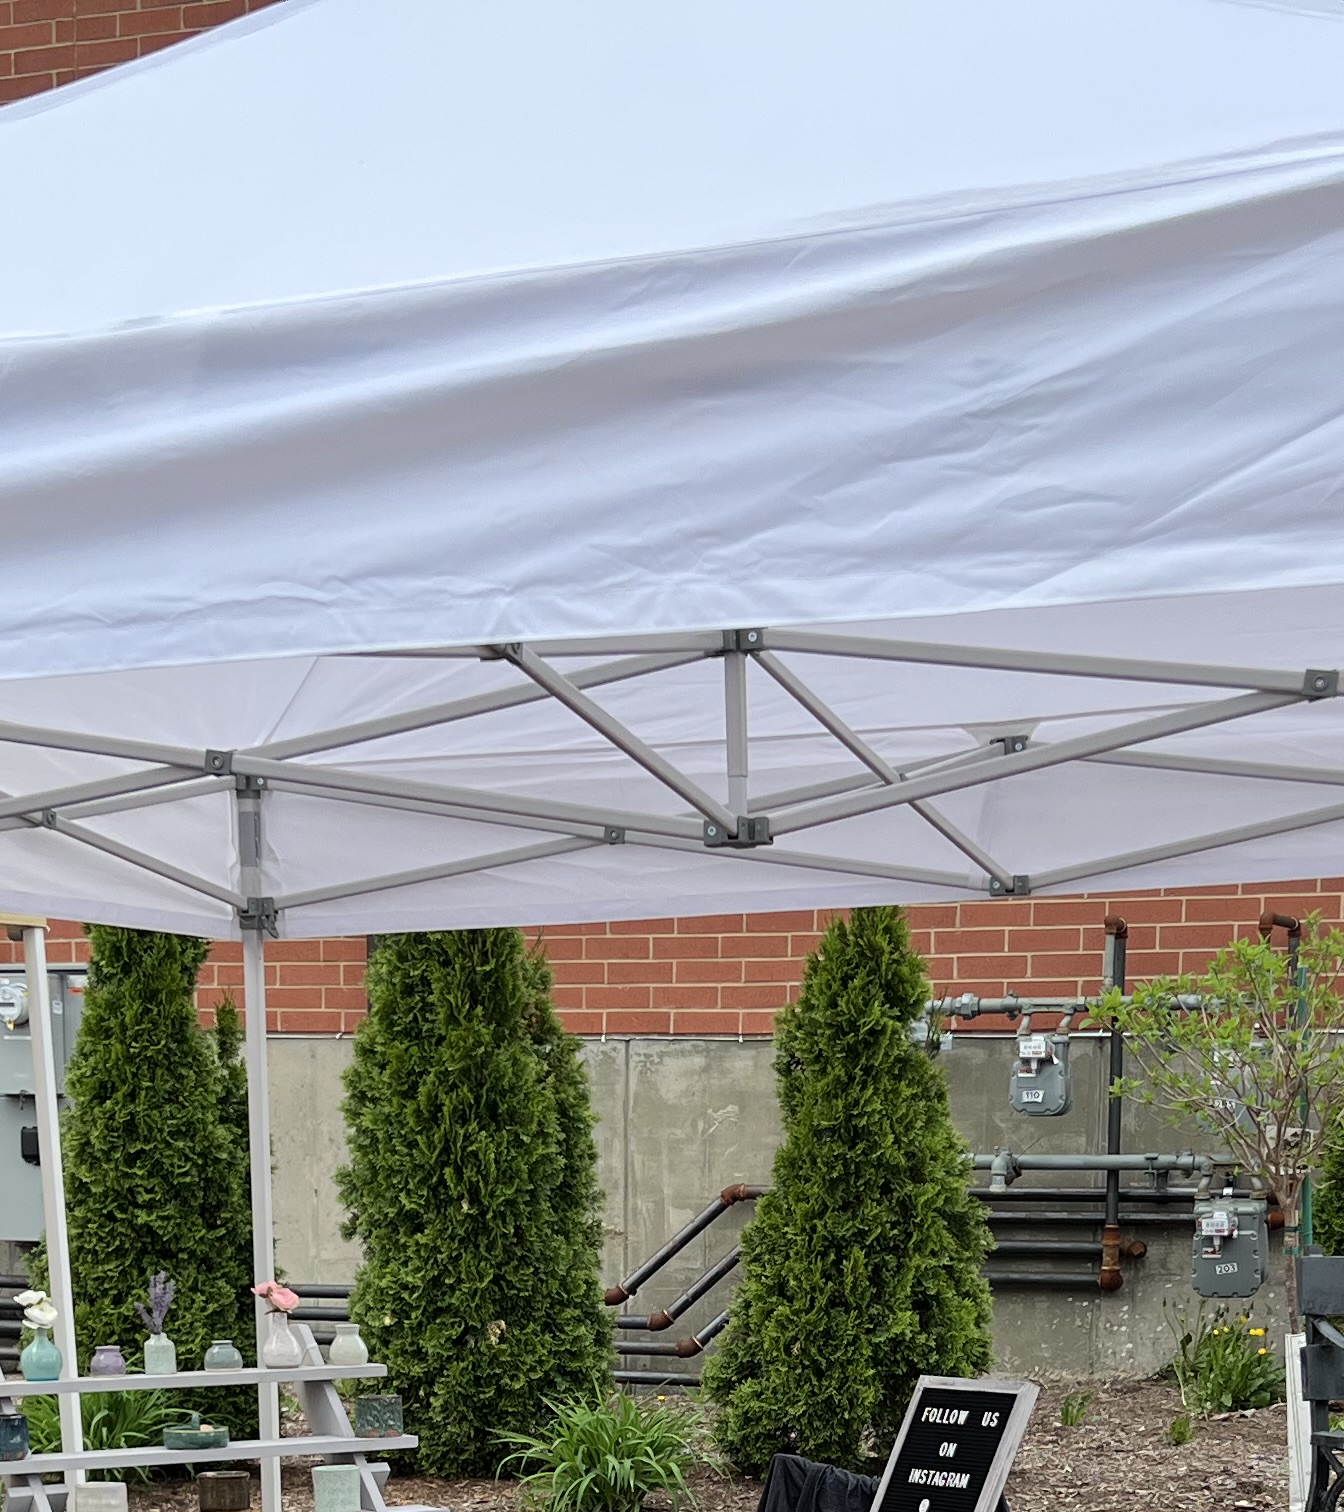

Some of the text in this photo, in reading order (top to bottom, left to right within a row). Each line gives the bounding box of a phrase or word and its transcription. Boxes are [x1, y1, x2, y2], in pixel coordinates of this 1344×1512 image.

[1026, 1091, 1040, 1100] 110
[1217, 1263, 1236, 1274] 203
[921, 1407, 1000, 1427] FOLLOW US
[939, 1441, 958, 1458] ON
[908, 1468, 970, 1489] INSTAGRAM
